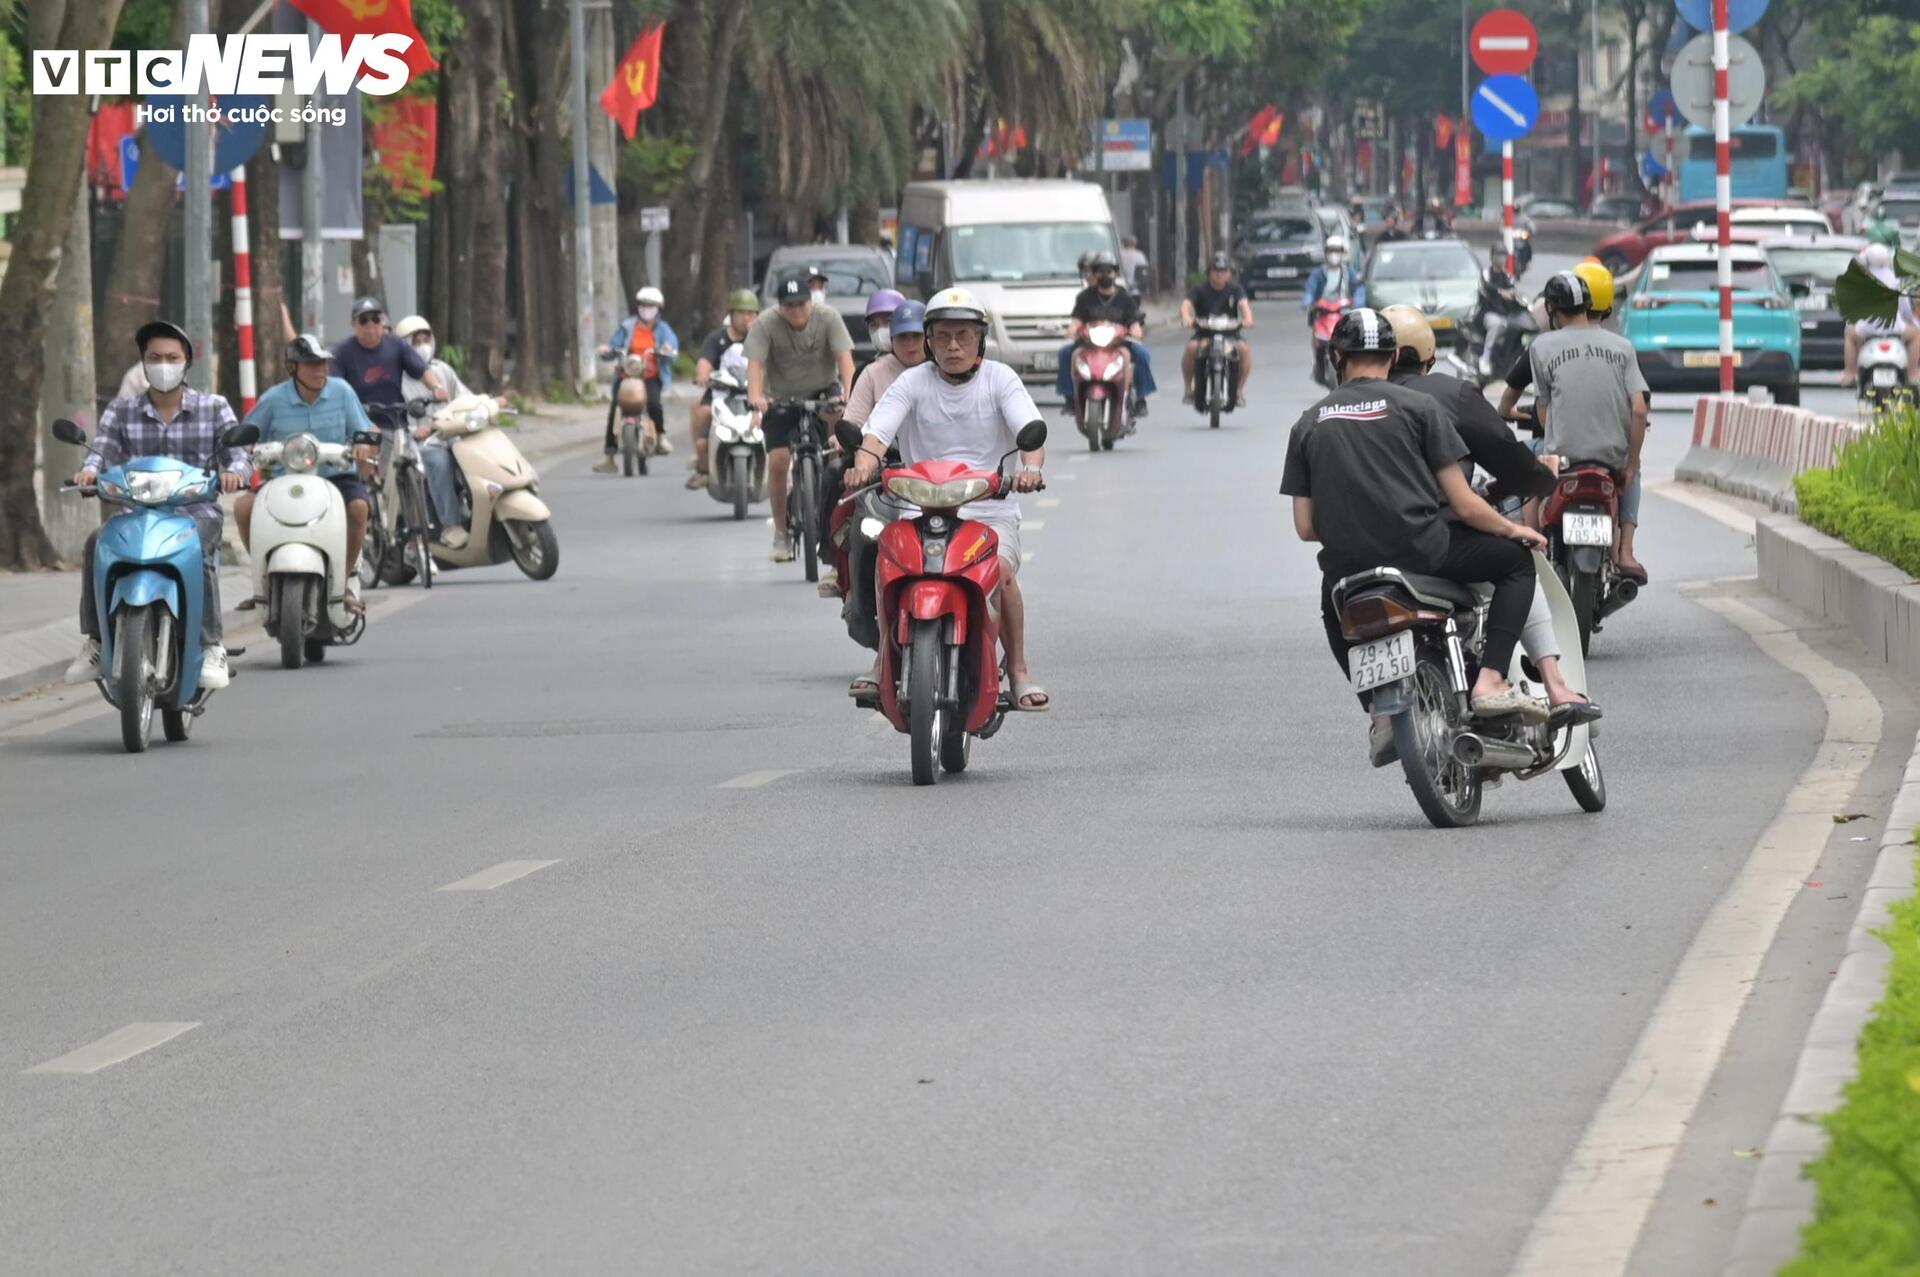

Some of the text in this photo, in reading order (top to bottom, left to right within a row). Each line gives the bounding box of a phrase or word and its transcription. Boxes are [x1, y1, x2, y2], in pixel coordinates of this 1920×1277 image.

[1319, 399, 1387, 417] Balenciaga
[1359, 637, 1402, 667] 29-X1
[1356, 655, 1410, 689] 232.50
